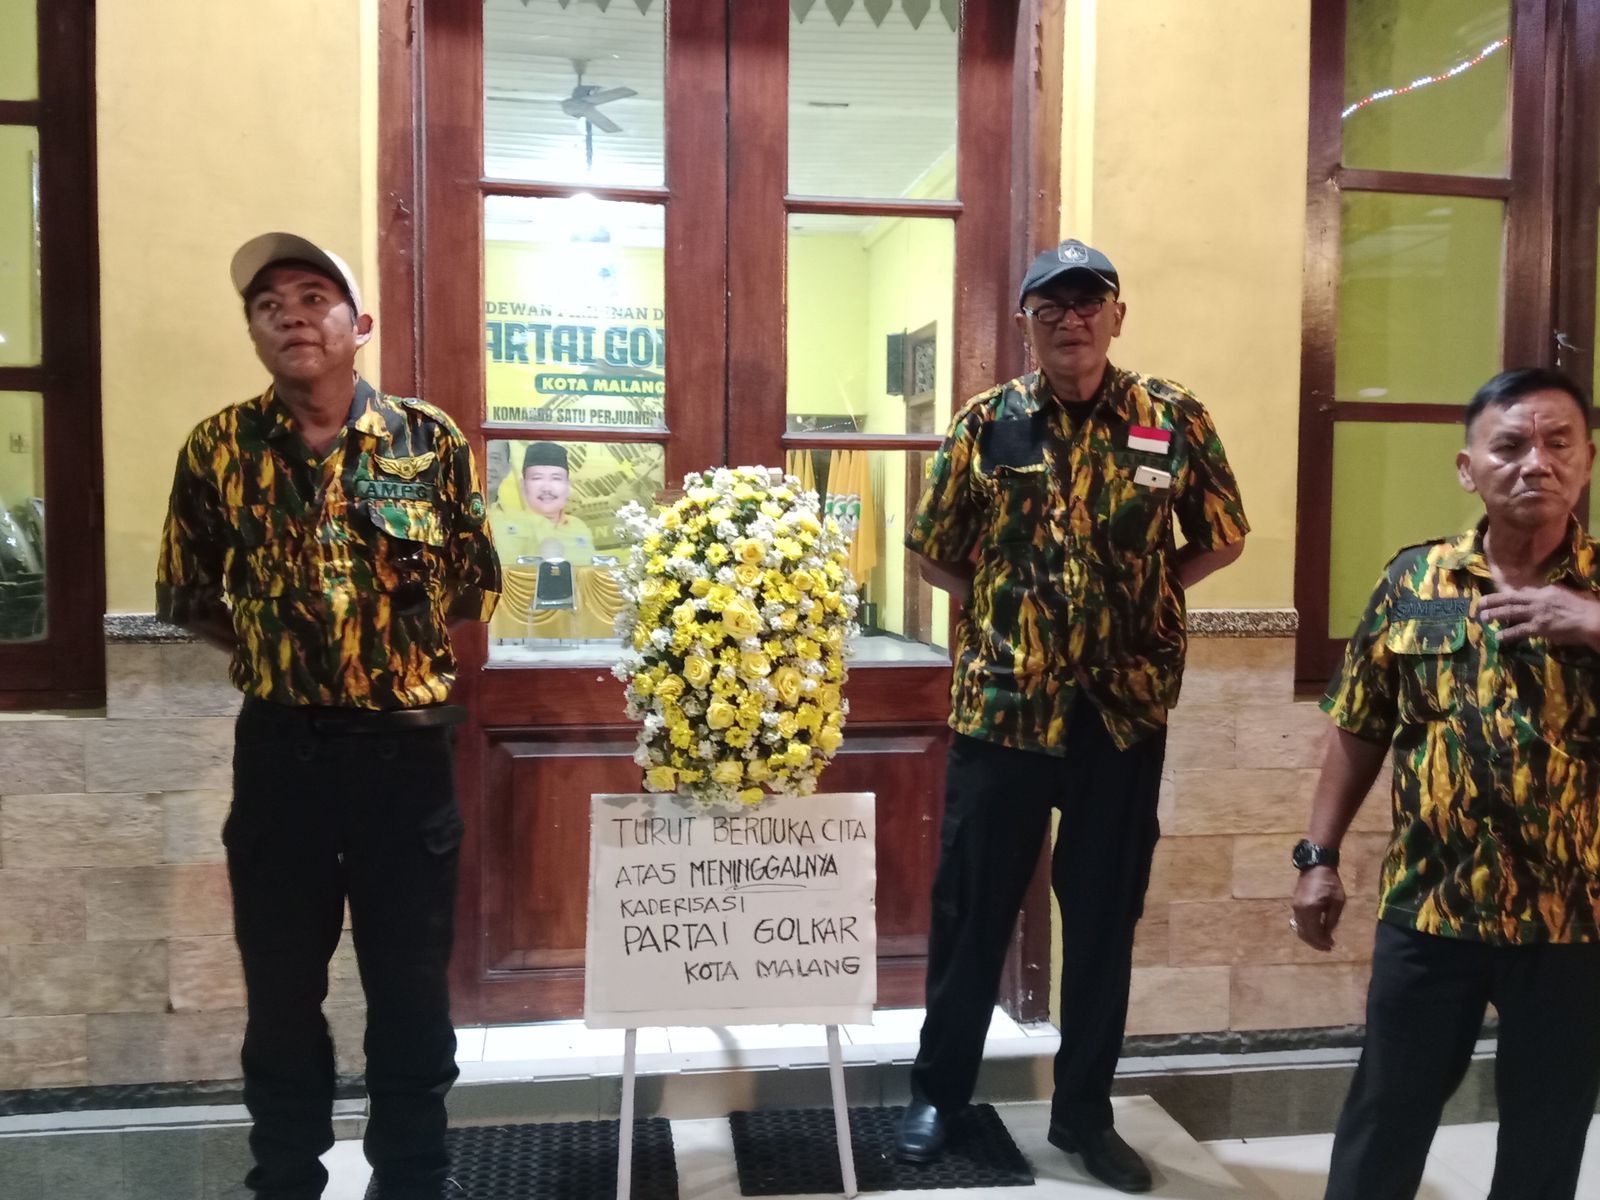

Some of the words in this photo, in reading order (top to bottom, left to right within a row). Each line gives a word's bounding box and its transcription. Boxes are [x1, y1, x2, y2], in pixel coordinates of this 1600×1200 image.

[486, 301, 552, 317] DEWAN
[542, 377, 588, 391] KOTA
[593, 379, 665, 393] MALANG
[556, 407, 586, 423] SATU
[366, 482, 428, 499] AMPG
[612, 816, 696, 848] TURUT
[713, 816, 815, 846] BERDUKA
[822, 818, 867, 842] CITA
[615, 863, 677, 888] ATAS
[690, 853, 838, 888] MENINGGALNYA
[620, 896, 745, 919] KADERISASI
[624, 921, 729, 955] PARTAI
[754, 916, 860, 945] GOLKAR
[684, 961, 739, 984] KOTA
[756, 956, 860, 978] MALANG
